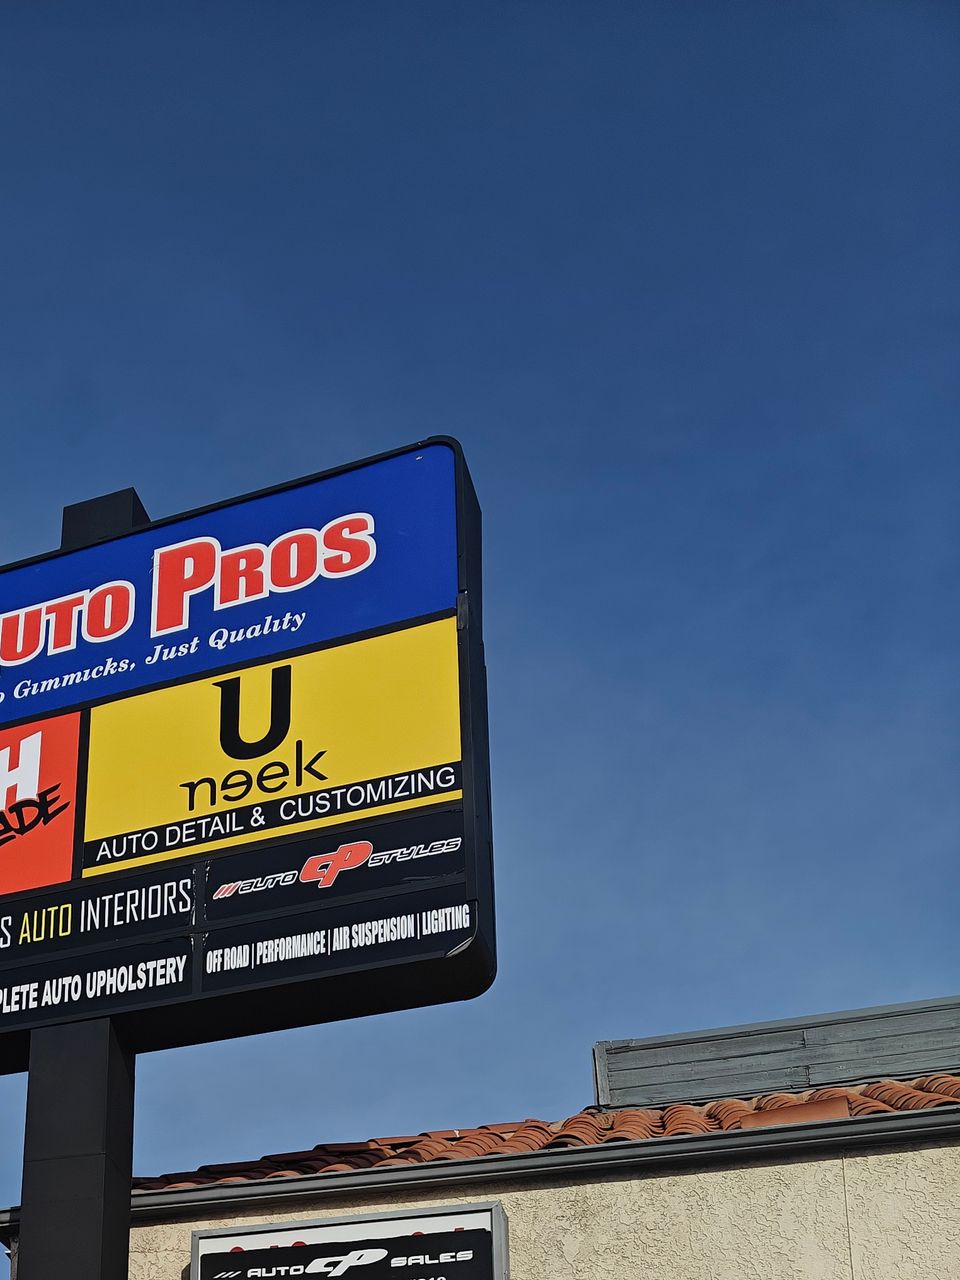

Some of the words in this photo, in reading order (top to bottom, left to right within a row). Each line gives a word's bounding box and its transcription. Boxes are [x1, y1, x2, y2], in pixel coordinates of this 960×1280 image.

[150, 512, 376, 638] PROS
[13, 657, 136, 698] Gimmicks,
[145, 638, 200, 665] Just
[208, 610, 306, 649] Quality
[212, 664, 292, 760] U
[179, 739, 329, 811] neek
[96, 831, 158, 861] AUTO
[165, 813, 244, 845] DETAIL
[250, 805, 266, 827] &
[279, 765, 456, 821] CUSTOMIZING
[238, 870, 298, 894] AUTO
[299, 840, 373, 888] CP
[367, 837, 462, 868] STYLES
[18, 903, 72, 945] AUTO
[80, 878, 191, 933] INTERIORS
[206, 948, 223, 974] OFF
[223, 944, 250, 971] ROAD
[256, 930, 326, 965] PERFORMANCE
[332, 926, 350, 951] AIR
[351, 913, 415, 948] SUSPENSION
[422, 903, 470, 936] LIGHTING
[41, 974, 82, 1007] AUTO
[85, 954, 187, 998] UPHOLSTERY
[247, 1265, 304, 1278] AUTO
[304, 1248, 389, 1278] CP
[390, 1250, 473, 1267] SALES
